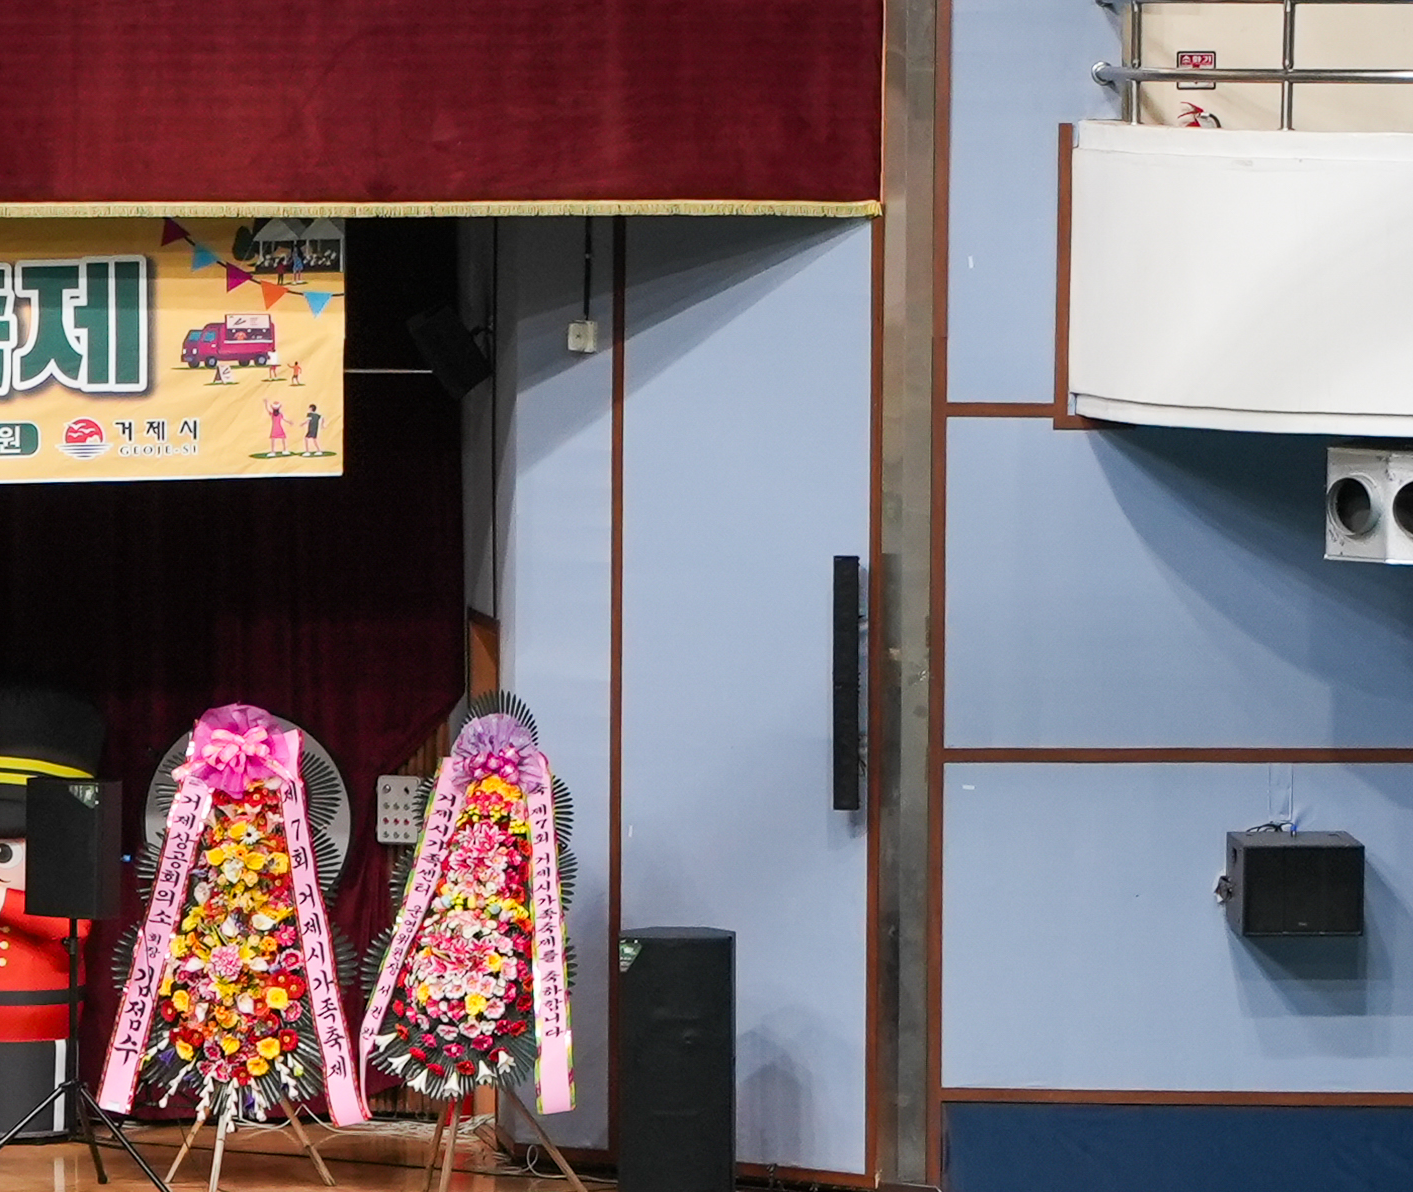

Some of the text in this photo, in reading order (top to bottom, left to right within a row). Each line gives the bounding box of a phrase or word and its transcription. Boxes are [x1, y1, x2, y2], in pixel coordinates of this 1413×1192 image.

[120, 444, 197, 456] GEOJE-SI
[414, 792, 456, 898] 거제시가족센터
[114, 792, 202, 1066] 거제상공회의소 회장 김점수
[386, 904, 423, 977] 운영위원장
[534, 855, 559, 963] 거제시가족축제를
[298, 886, 347, 1080] 거제시가족축제
[541, 969, 565, 1039] 축하합니다
